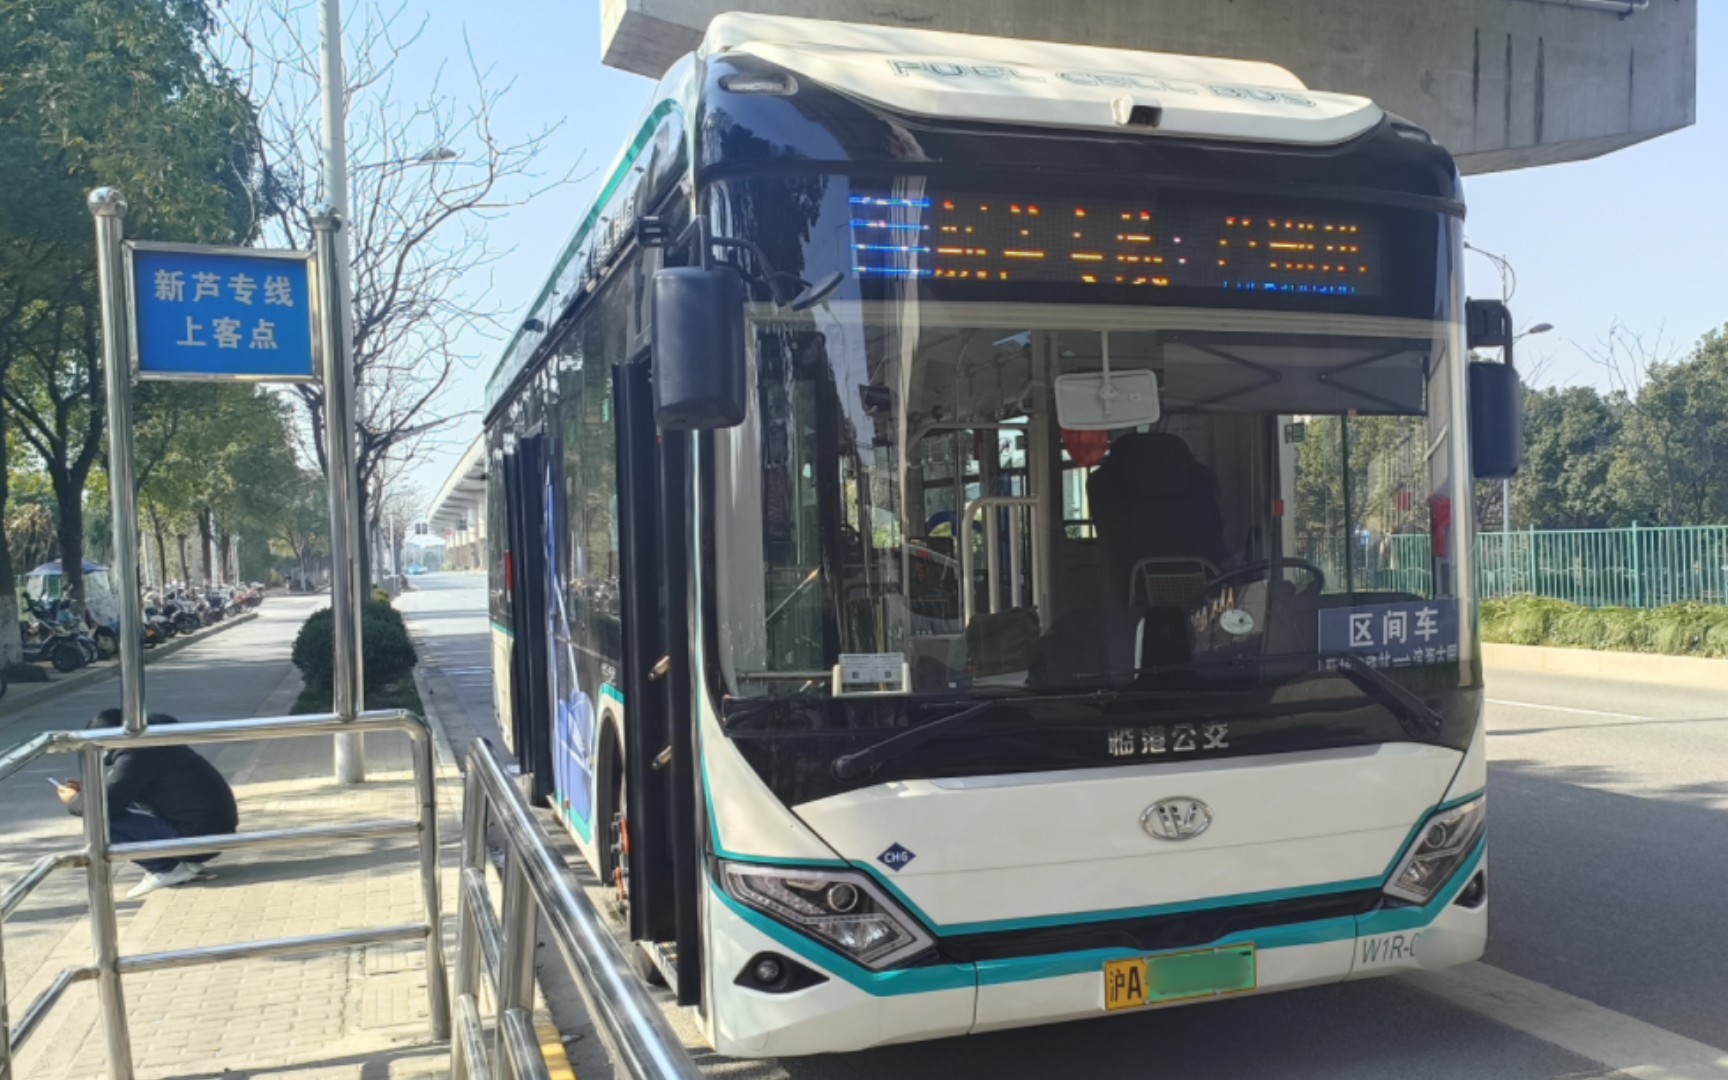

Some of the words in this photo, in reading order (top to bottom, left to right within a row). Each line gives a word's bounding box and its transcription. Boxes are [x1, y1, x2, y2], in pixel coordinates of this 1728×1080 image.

[887, 59, 1046, 83] FUEL
[1056, 71, 1198, 95] CELL
[1208, 84, 1316, 108] BUS
[154, 268, 294, 308] 新芦专线
[176, 315, 279, 350] 上客点
[1349, 605, 1440, 648] 区间车
[1107, 720, 1230, 758] 临港公交
